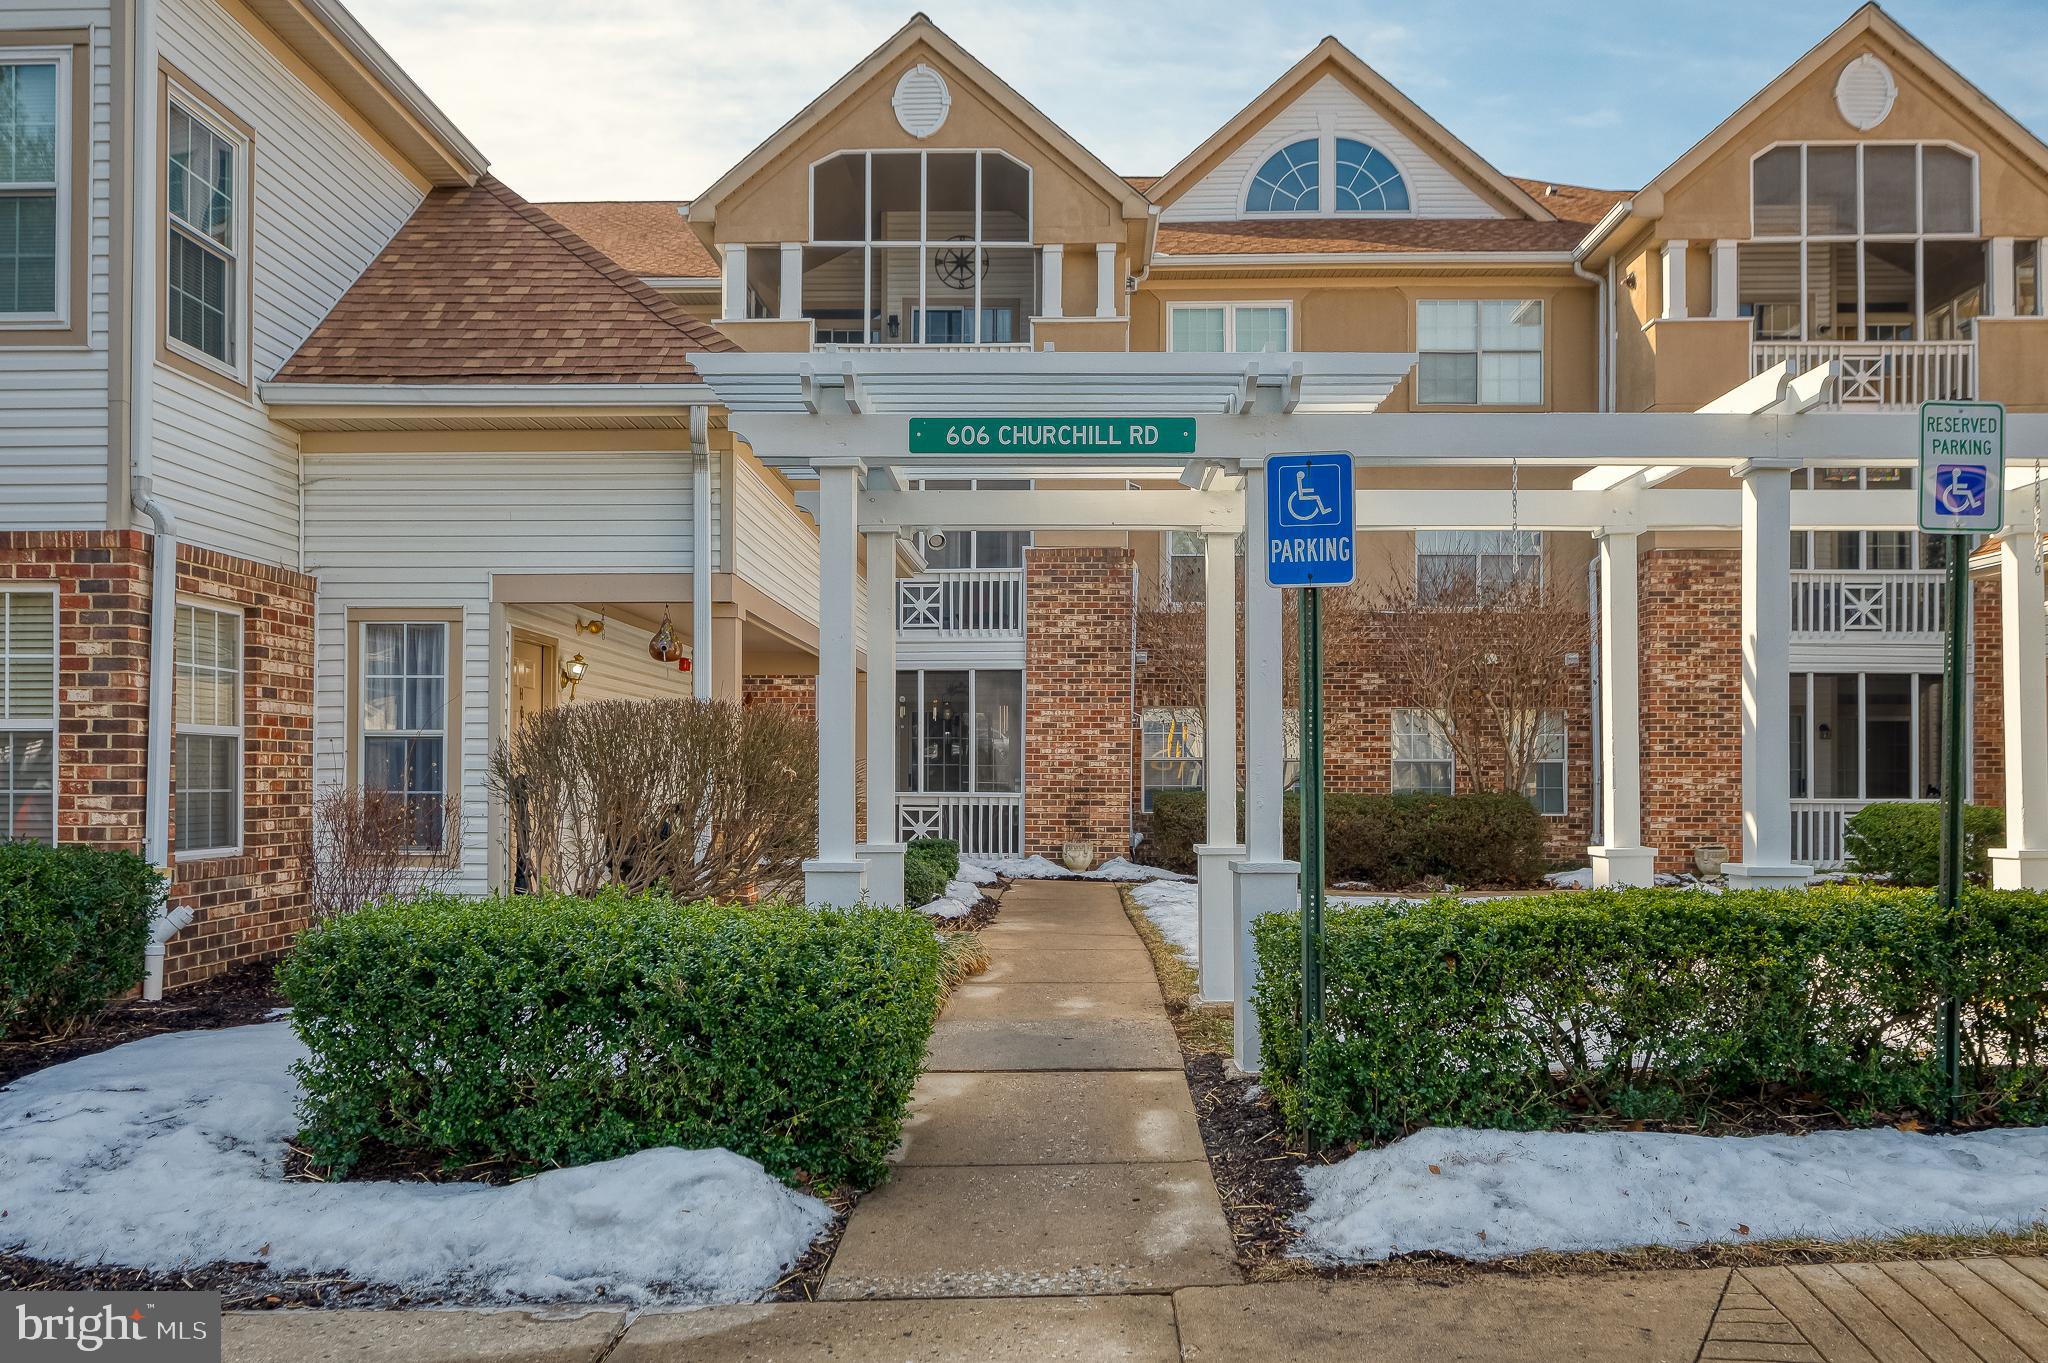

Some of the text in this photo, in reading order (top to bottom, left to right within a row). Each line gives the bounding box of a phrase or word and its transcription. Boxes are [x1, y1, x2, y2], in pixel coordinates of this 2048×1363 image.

[1927, 416, 1997, 433] RESERVED
[946, 425, 1159, 445] 606 CHURCHILL RD
[1932, 439, 1992, 455] PARKING
[1271, 537, 1350, 563] PARKING
